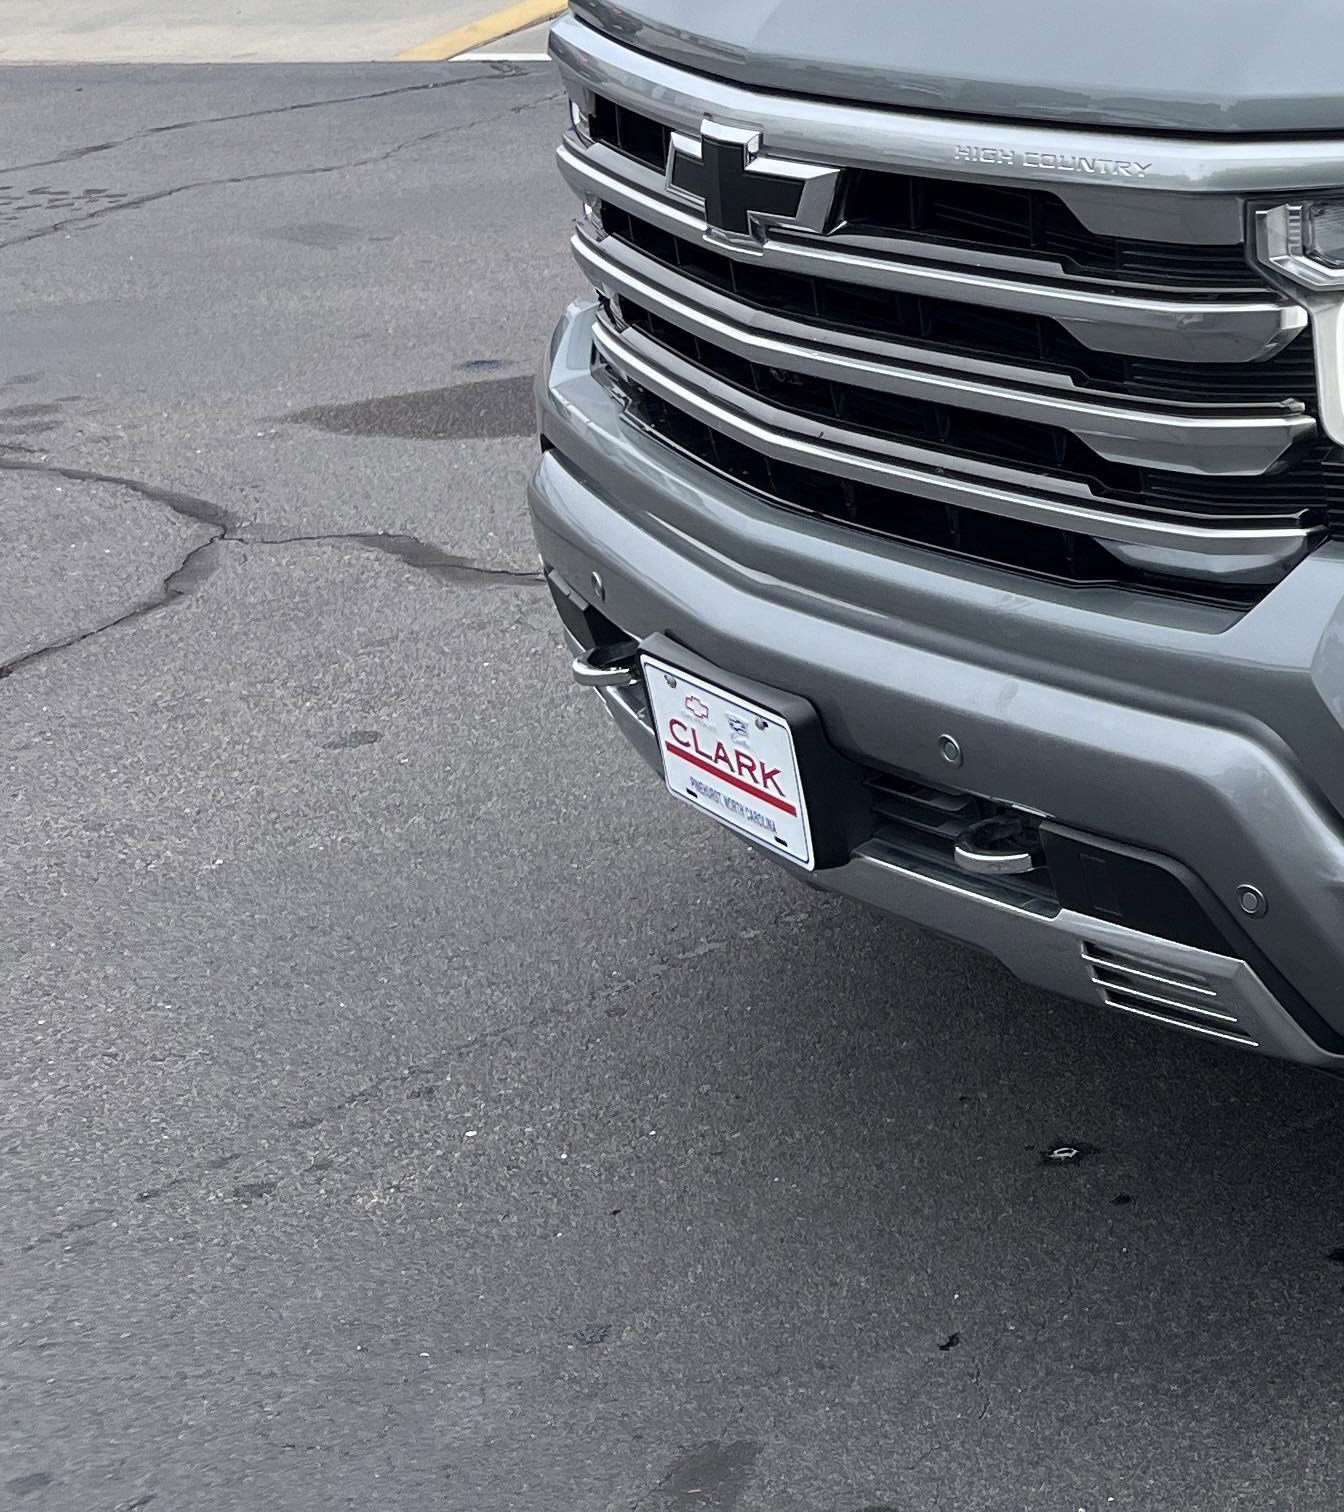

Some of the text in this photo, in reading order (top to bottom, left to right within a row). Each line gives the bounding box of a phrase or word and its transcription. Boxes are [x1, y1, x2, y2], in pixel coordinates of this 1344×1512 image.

[954, 145, 1153, 178] HIGH COUNTRY
[668, 718, 786, 797] CLARK
